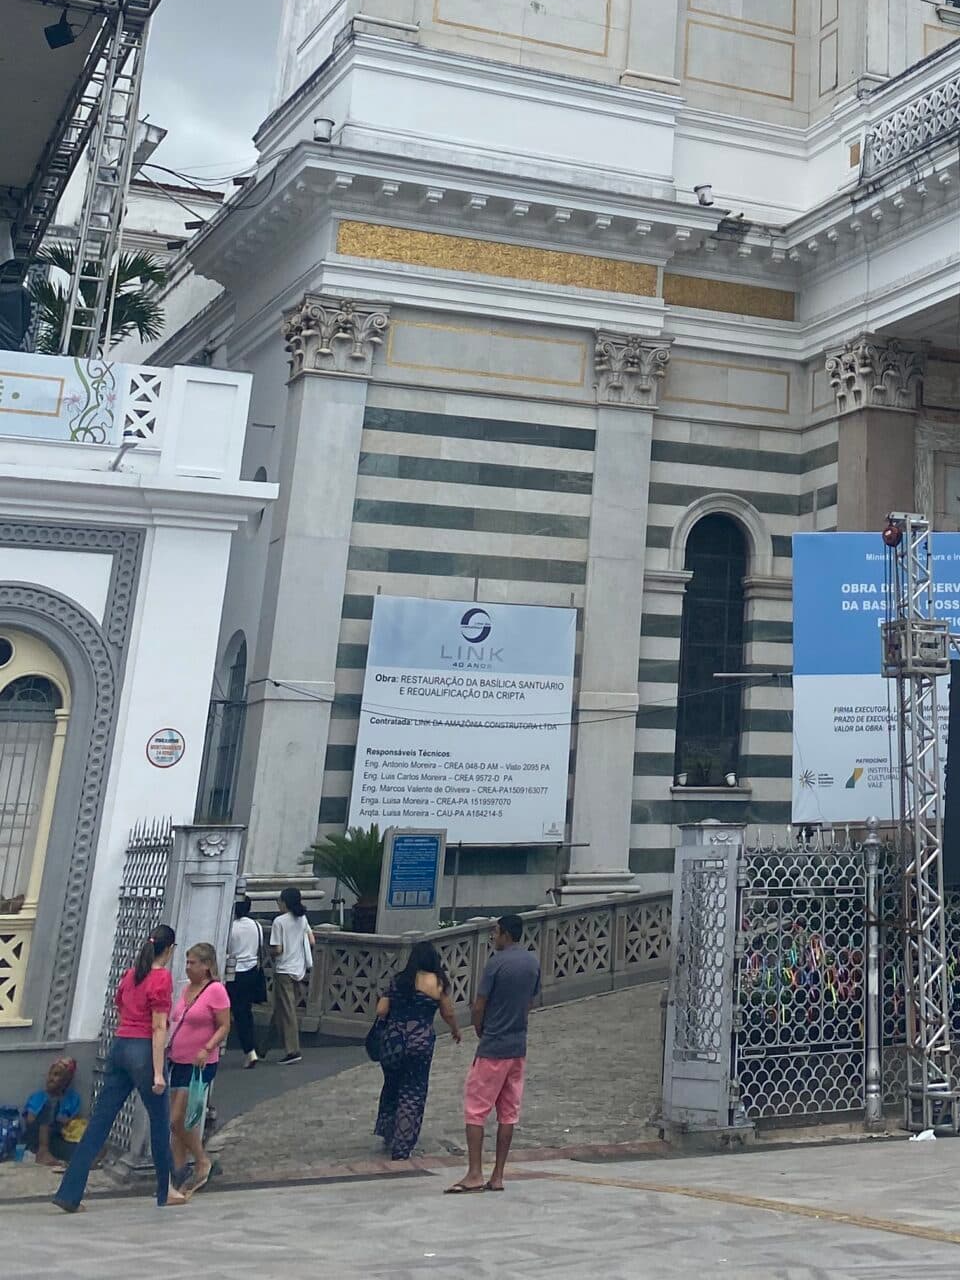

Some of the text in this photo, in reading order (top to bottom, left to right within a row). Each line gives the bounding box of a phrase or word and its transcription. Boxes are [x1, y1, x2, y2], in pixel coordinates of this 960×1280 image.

[841, 583, 877, 593] OBRA
[842, 600, 858, 610] DA
[440, 645, 505, 662] LINK
[375, 674, 564, 690] Obra: RESTAURAÇÃO DA BASÍLICA SANTUÁRIO
[407, 688, 480, 700] REQUALIFICAÇÃO
[482, 690, 494, 699] DA
[496, 692, 525, 700] CRIPTA
[834, 715, 854, 723] PRAZO
[367, 748, 416, 758] Responsáveis
[402, 797, 429, 805] Moreira
[436, 809, 464, 817] CAU-PA
